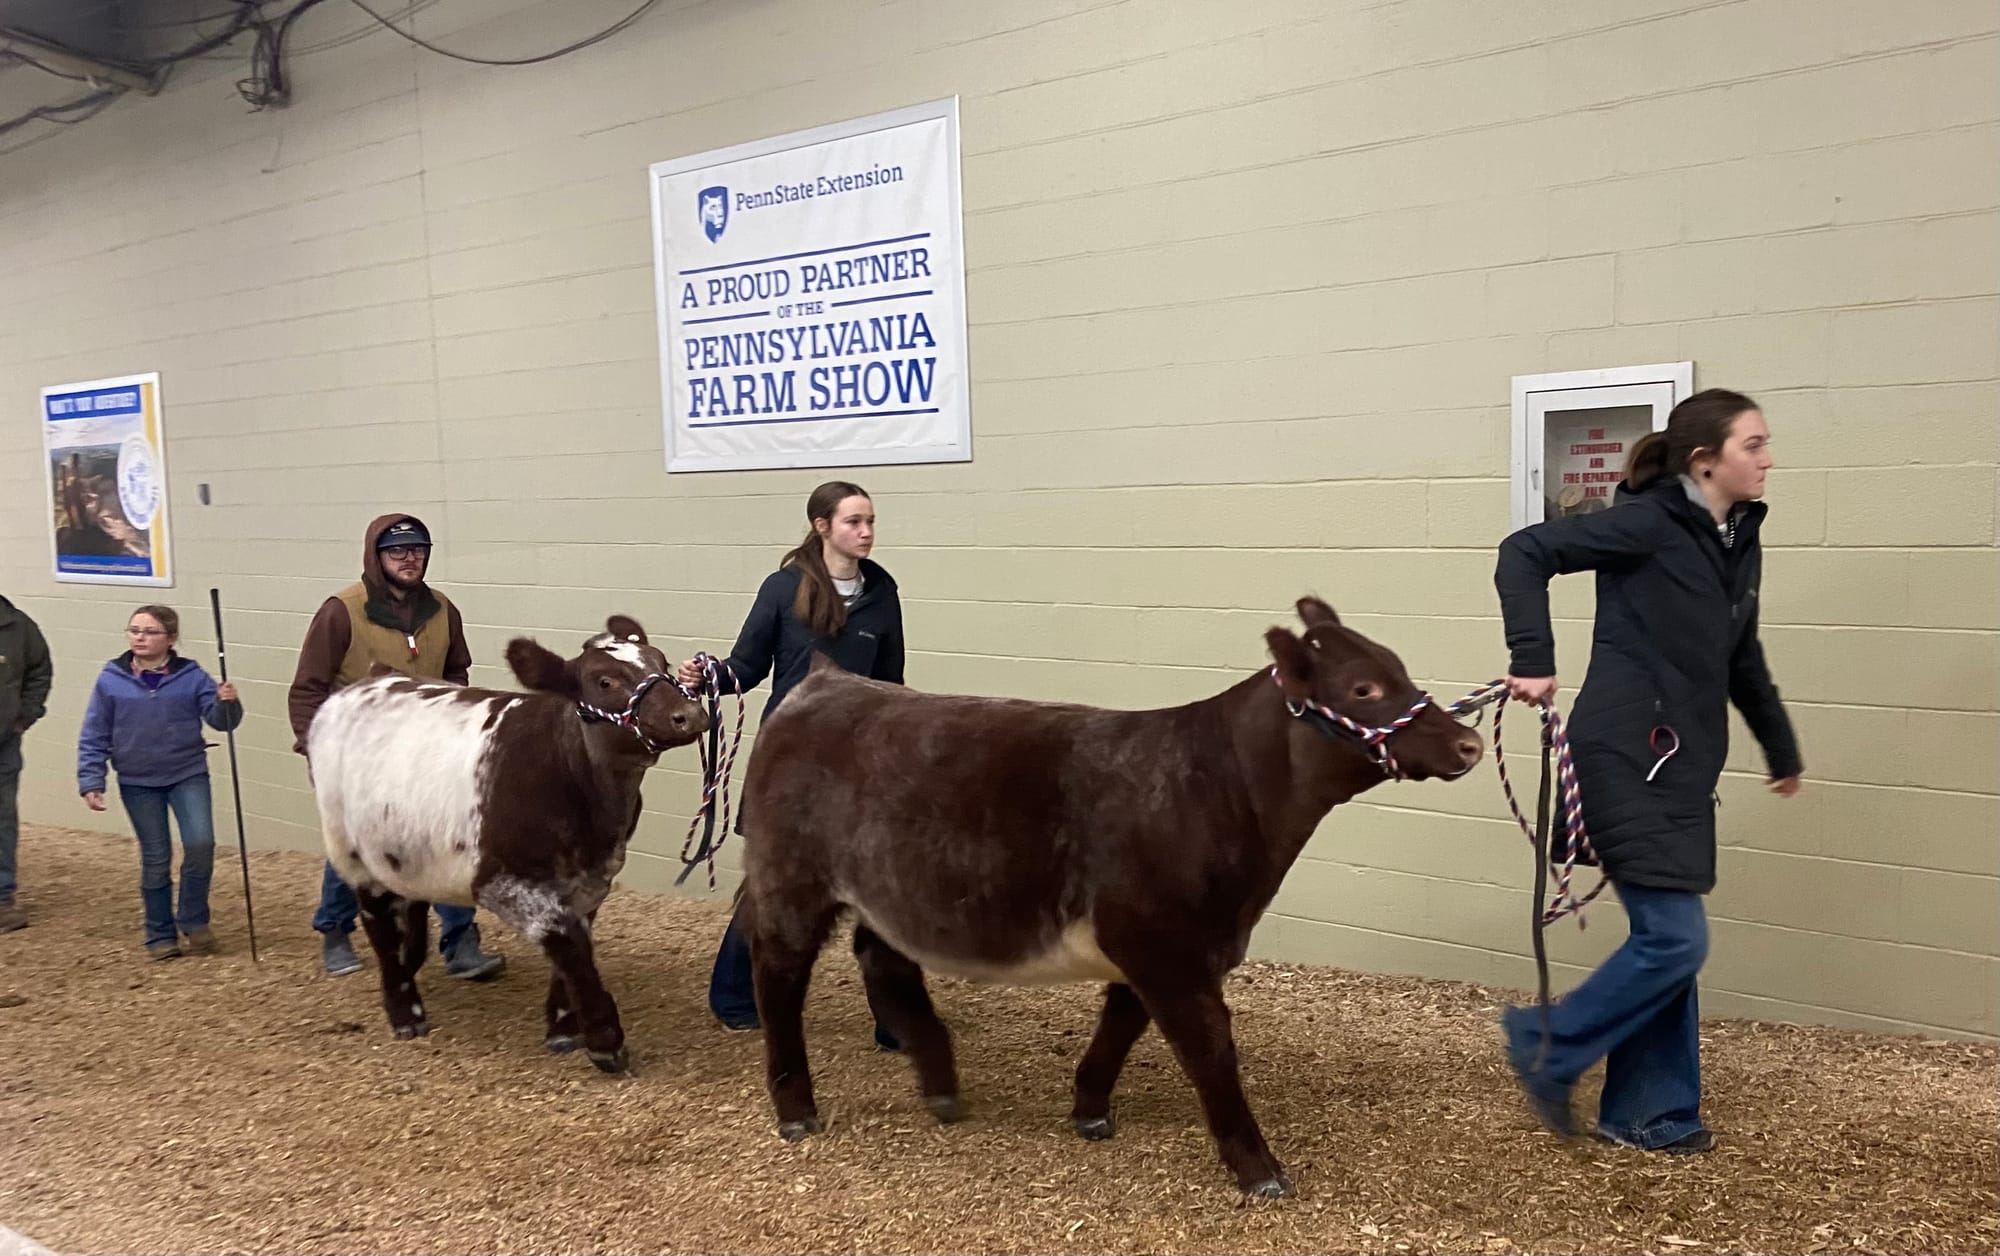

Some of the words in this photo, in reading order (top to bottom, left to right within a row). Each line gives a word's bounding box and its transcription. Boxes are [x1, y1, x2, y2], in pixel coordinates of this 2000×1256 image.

[816, 163, 904, 197] Extension
[681, 282, 699, 309] A
[707, 269, 791, 307] PROUD
[801, 247, 932, 294] PARTNER
[777, 305, 792, 319] OF
[796, 300, 825, 316] THE
[685, 312, 937, 371] PENNSYLVANIA
[688, 370, 798, 418] FARM
[809, 357, 937, 411] SHOW
[1563, 473, 1580, 484] FIRE
